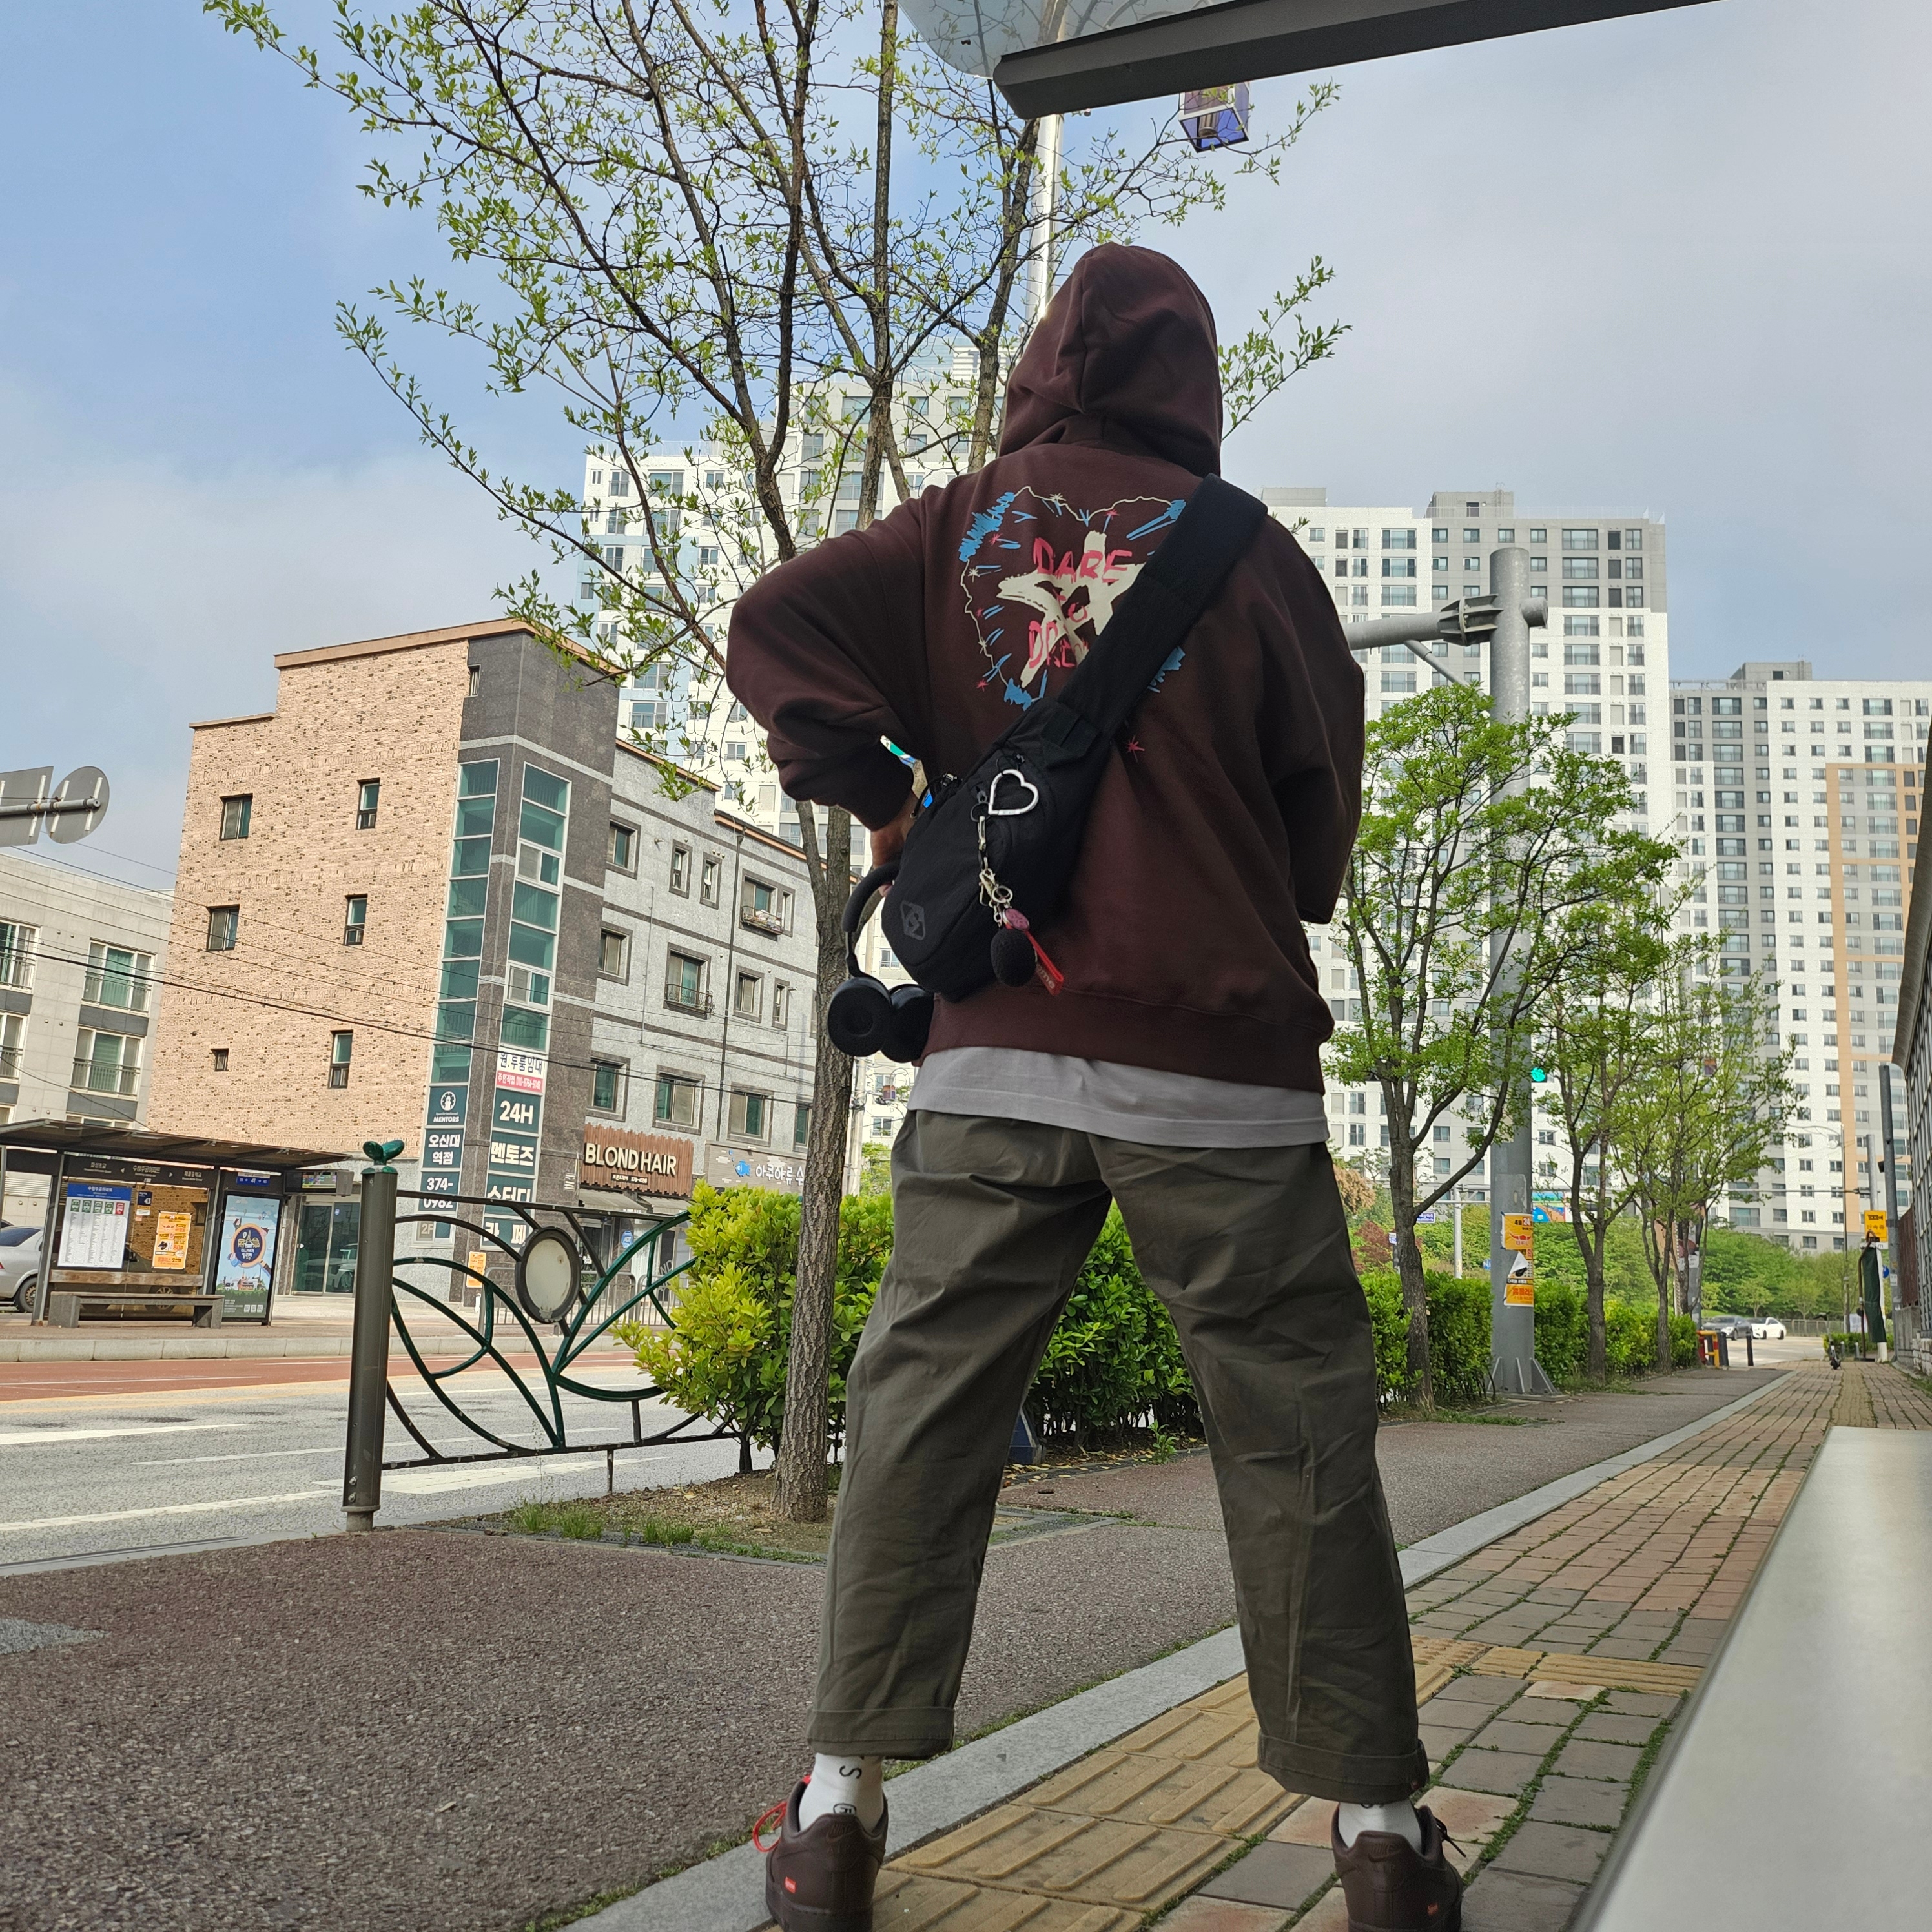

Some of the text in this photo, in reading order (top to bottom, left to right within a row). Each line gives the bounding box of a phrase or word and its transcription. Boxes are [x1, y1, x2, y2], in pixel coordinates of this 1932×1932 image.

[1034, 537, 1132, 583] DARE
[1029, 621, 1089, 668] DRE
[500, 1100, 534, 1125] 24H
[428, 1134, 460, 1147] 오산대
[432, 1151, 453, 1165] 역점
[491, 1142, 534, 1166] 멘토즈
[584, 1142, 677, 1175] BLOND HAIR
[427, 1177, 453, 1191] 374-
[421, 1223, 433, 1235] 2F
